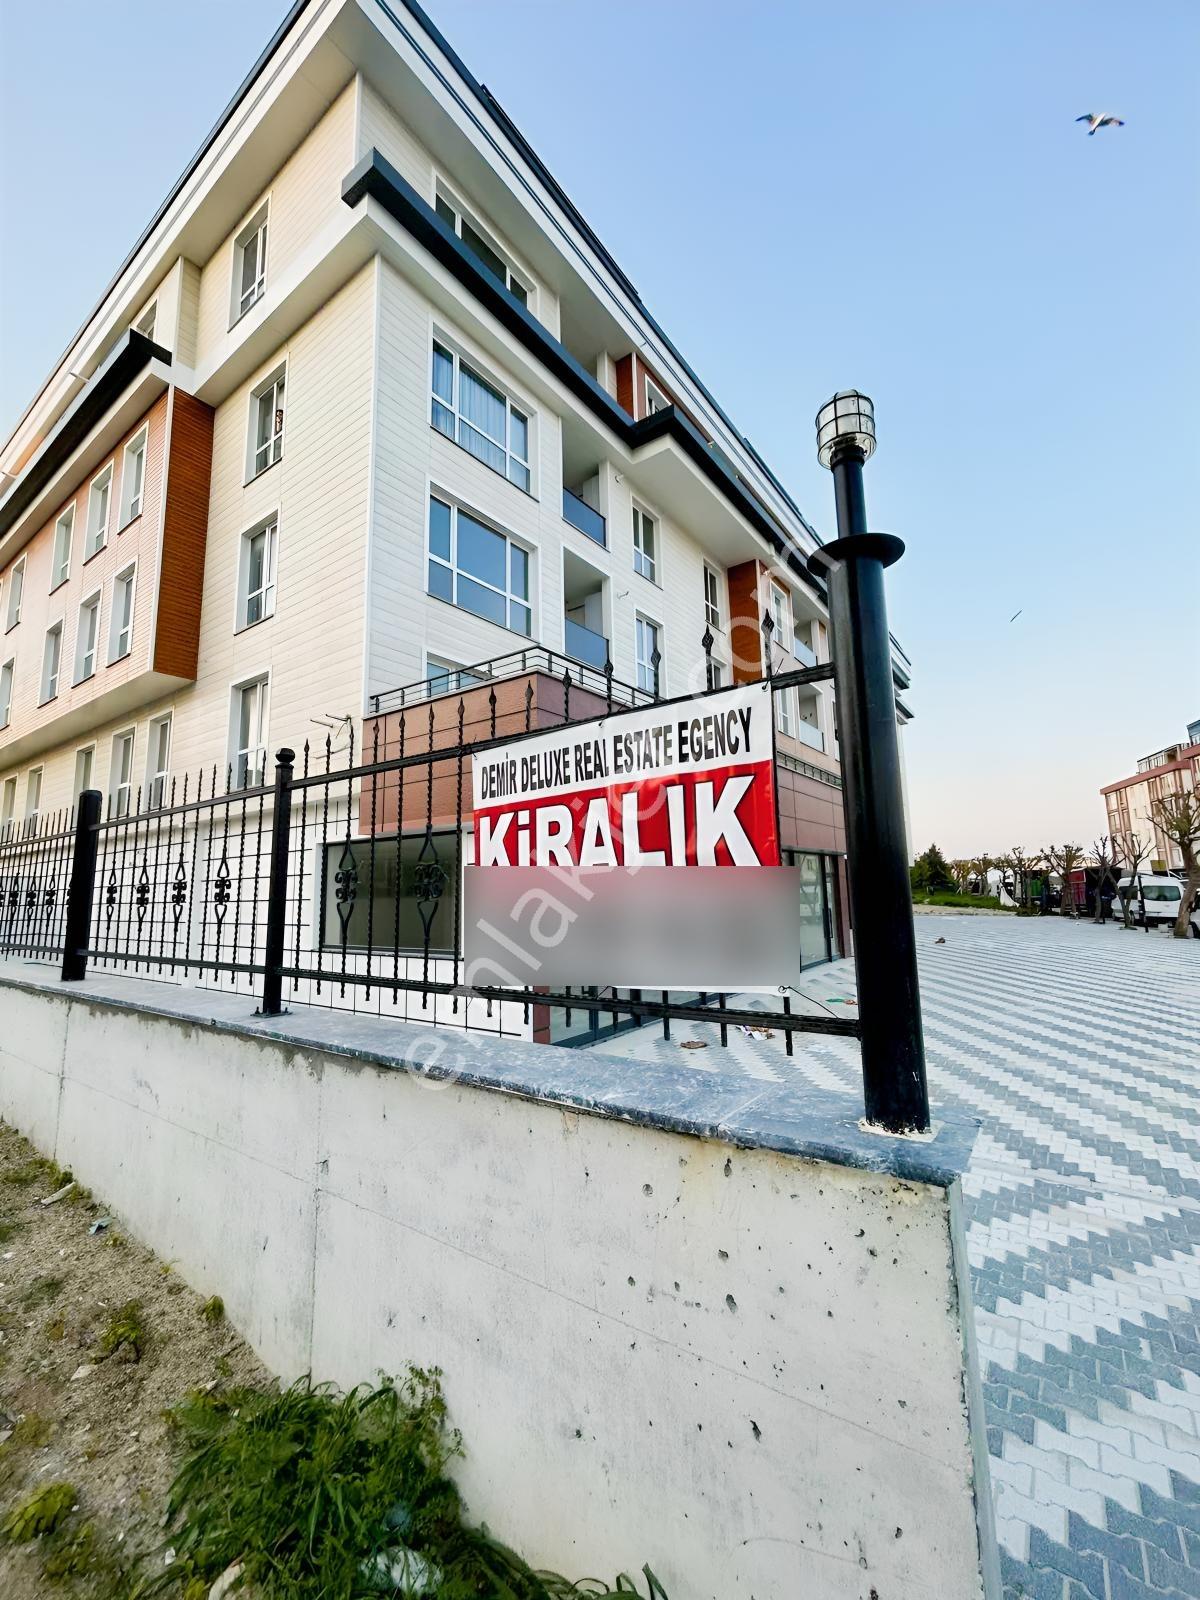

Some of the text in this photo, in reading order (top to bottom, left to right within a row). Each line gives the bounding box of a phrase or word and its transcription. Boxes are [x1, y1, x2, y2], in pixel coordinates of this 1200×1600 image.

[521, 747, 571, 792] DELUXE
[574, 739, 609, 783] REAL
[613, 724, 673, 775] ESTATE
[677, 706, 752, 763] EGENCY
